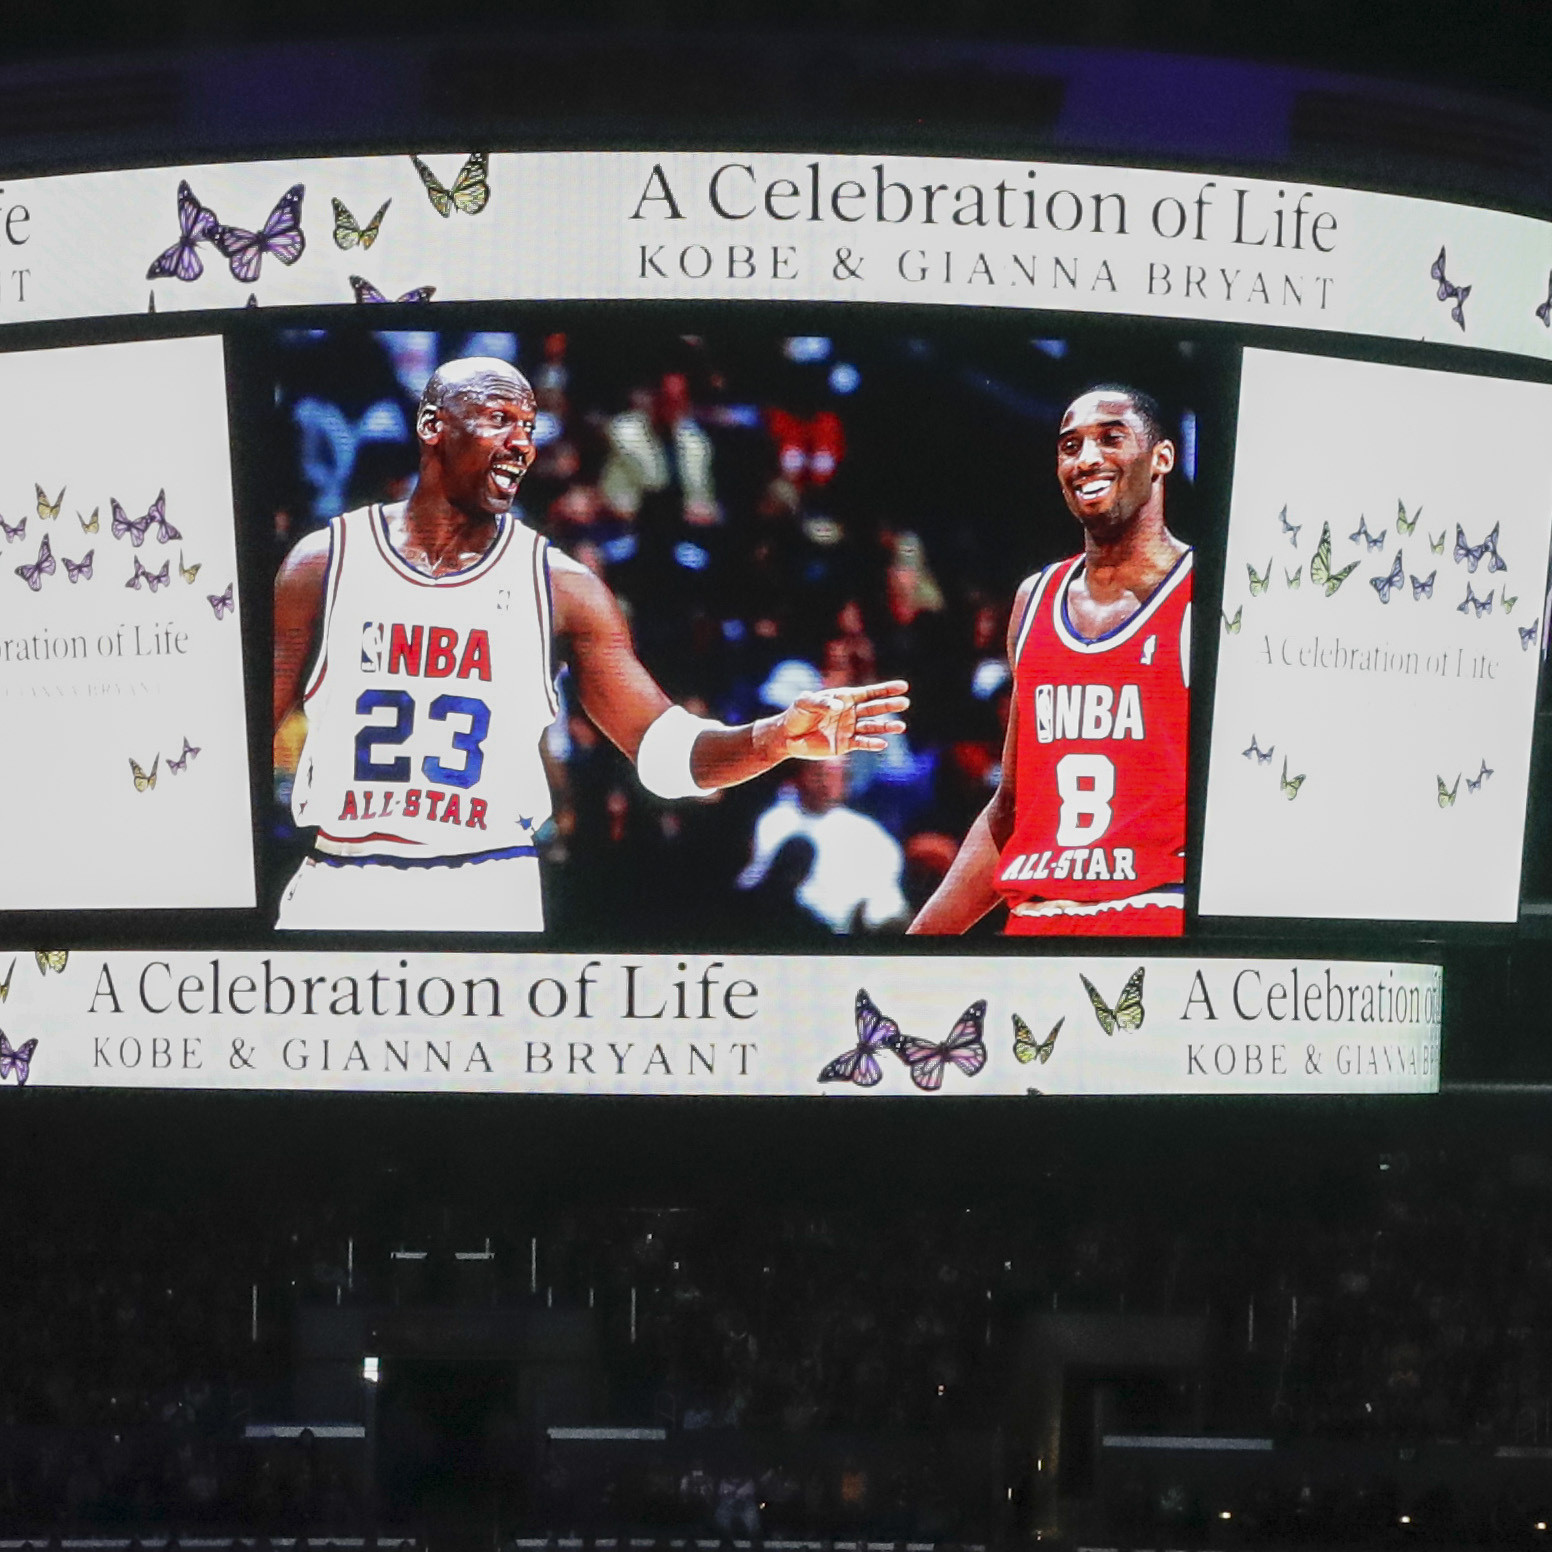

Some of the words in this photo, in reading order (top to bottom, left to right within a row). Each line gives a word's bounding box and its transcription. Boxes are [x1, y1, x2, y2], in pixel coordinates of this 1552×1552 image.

[628, 163, 687, 219] A
[708, 161, 1130, 235] Celebration
[1152, 182, 1217, 240] of
[1231, 188, 1339, 252] Life
[638, 245, 799, 279] KOBE
[832, 246, 865, 280] &
[898, 249, 1118, 292] GIANNA
[1148, 262, 1334, 310] BRYANT
[96, 623, 126, 659] of
[133, 620, 189, 658] Life
[388, 623, 492, 682] NBA
[1259, 634, 1273, 665] A
[1281, 636, 1419, 674] Celebration
[1427, 646, 1448, 676] of
[353, 688, 491, 789] 23
[1054, 684, 1145, 740] NBA
[1055, 753, 1116, 847] 8
[1001, 847, 1137, 881] ALL-STAR
[87, 961, 125, 1014] A
[138, 958, 506, 1017] Celebration
[528, 960, 602, 1018] of
[620, 960, 759, 1019] Life
[1179, 968, 1219, 1021] A
[1233, 965, 1421, 1023] Celebration
[93, 1036, 204, 1069] KOBE
[229, 1037, 256, 1071] &
[282, 1037, 495, 1073] GIANNA
[525, 1040, 759, 1076] BRYANT
[1186, 1043, 1288, 1076] KOBE
[1305, 1043, 1324, 1075] &
[1337, 1043, 1418, 1076] GIANNA
